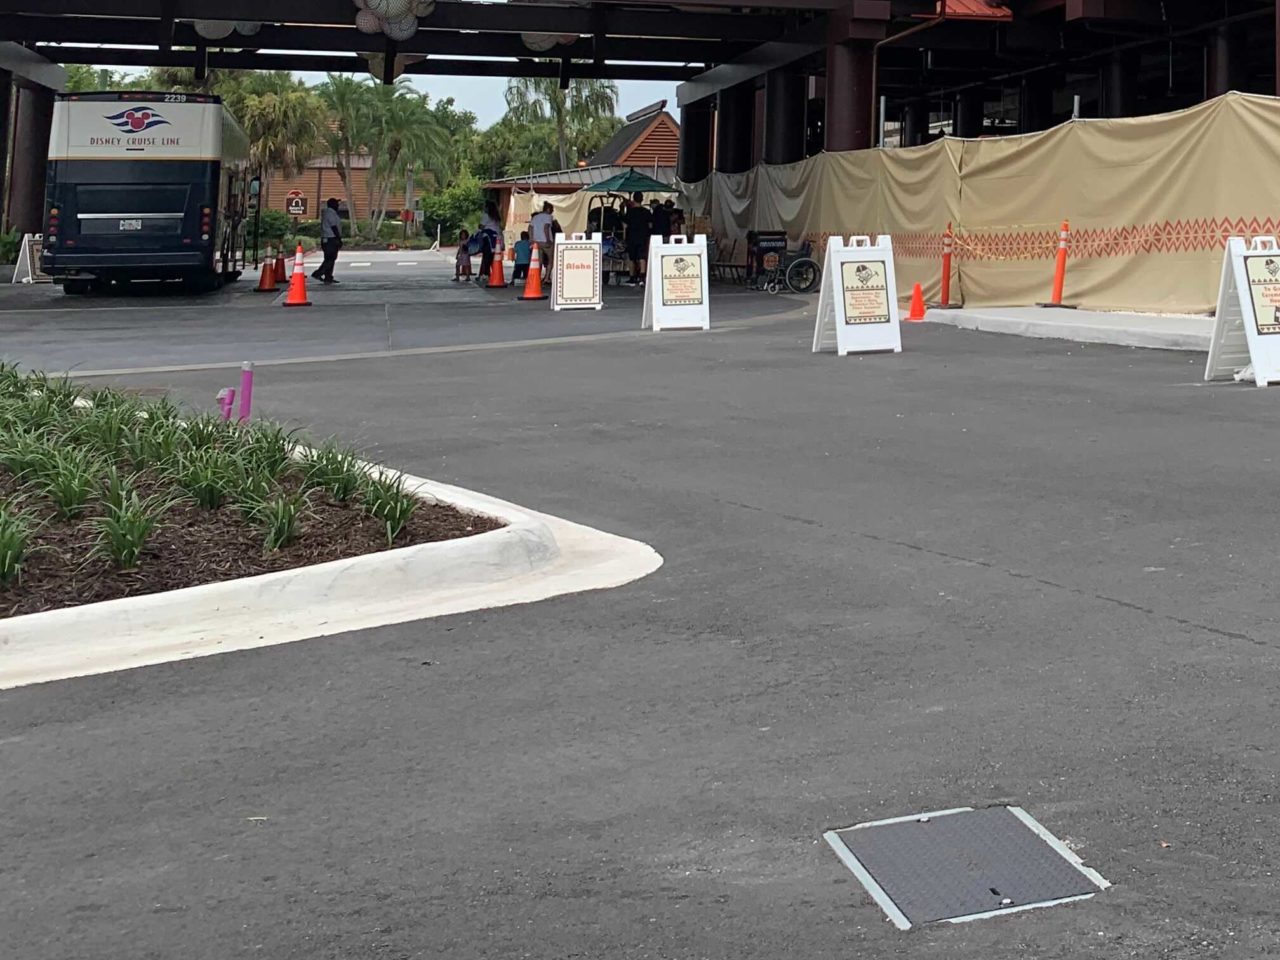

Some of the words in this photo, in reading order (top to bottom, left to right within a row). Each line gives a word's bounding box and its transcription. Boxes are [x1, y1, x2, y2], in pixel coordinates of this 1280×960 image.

[164, 94, 187, 102] 2239
[90, 137, 122, 146] DISNEY
[126, 137, 158, 146] CRUISE
[161, 137, 180, 146] LINE
[566, 262, 592, 270] Aloha
